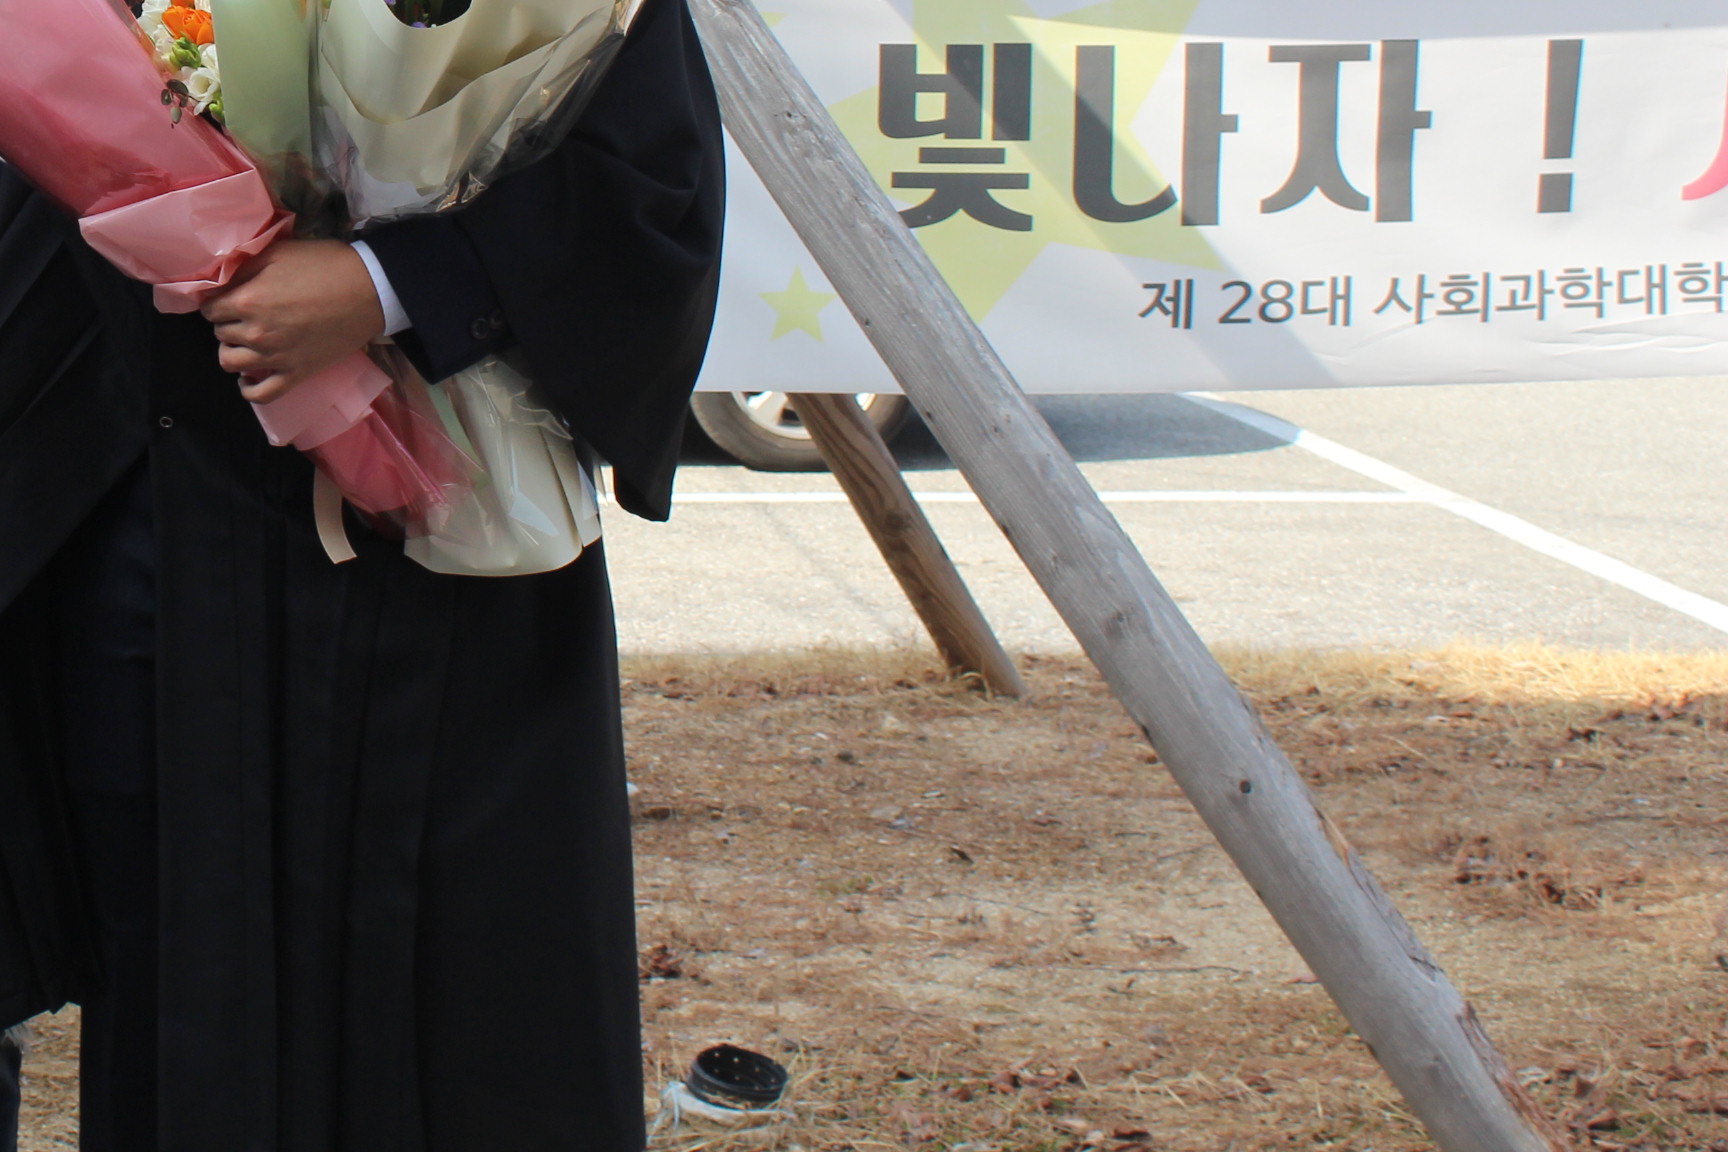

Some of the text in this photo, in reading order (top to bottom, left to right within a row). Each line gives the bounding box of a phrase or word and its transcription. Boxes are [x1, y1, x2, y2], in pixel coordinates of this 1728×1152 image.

[877, 38, 1432, 233] 빛나자
[1137, 261, 1728, 330] 제 28대 사회과학대학
